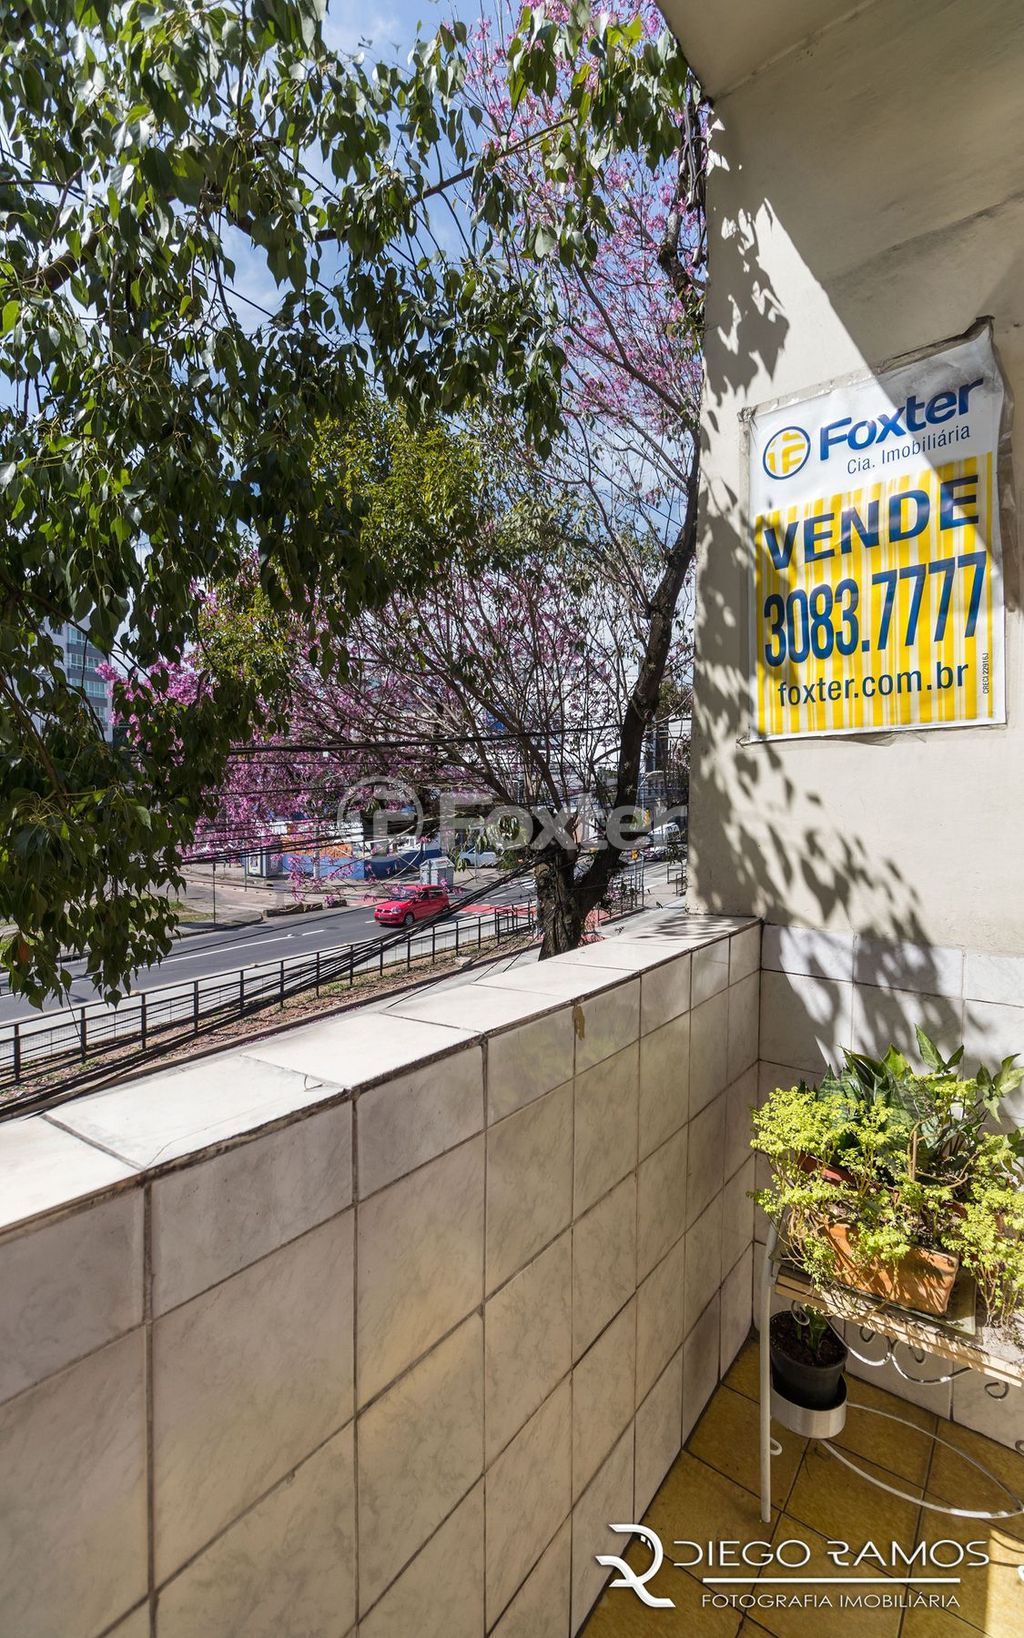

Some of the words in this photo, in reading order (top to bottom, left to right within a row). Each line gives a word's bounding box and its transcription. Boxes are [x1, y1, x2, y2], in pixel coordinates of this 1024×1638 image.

[820, 378, 983, 461] Foxter
[847, 458, 875, 474] Cia.
[882, 424, 971, 464] Imobiliária
[764, 474, 979, 571] VENDE
[763, 551, 987, 667] 3083.7777
[777, 661, 969, 707] foxter.com.br
